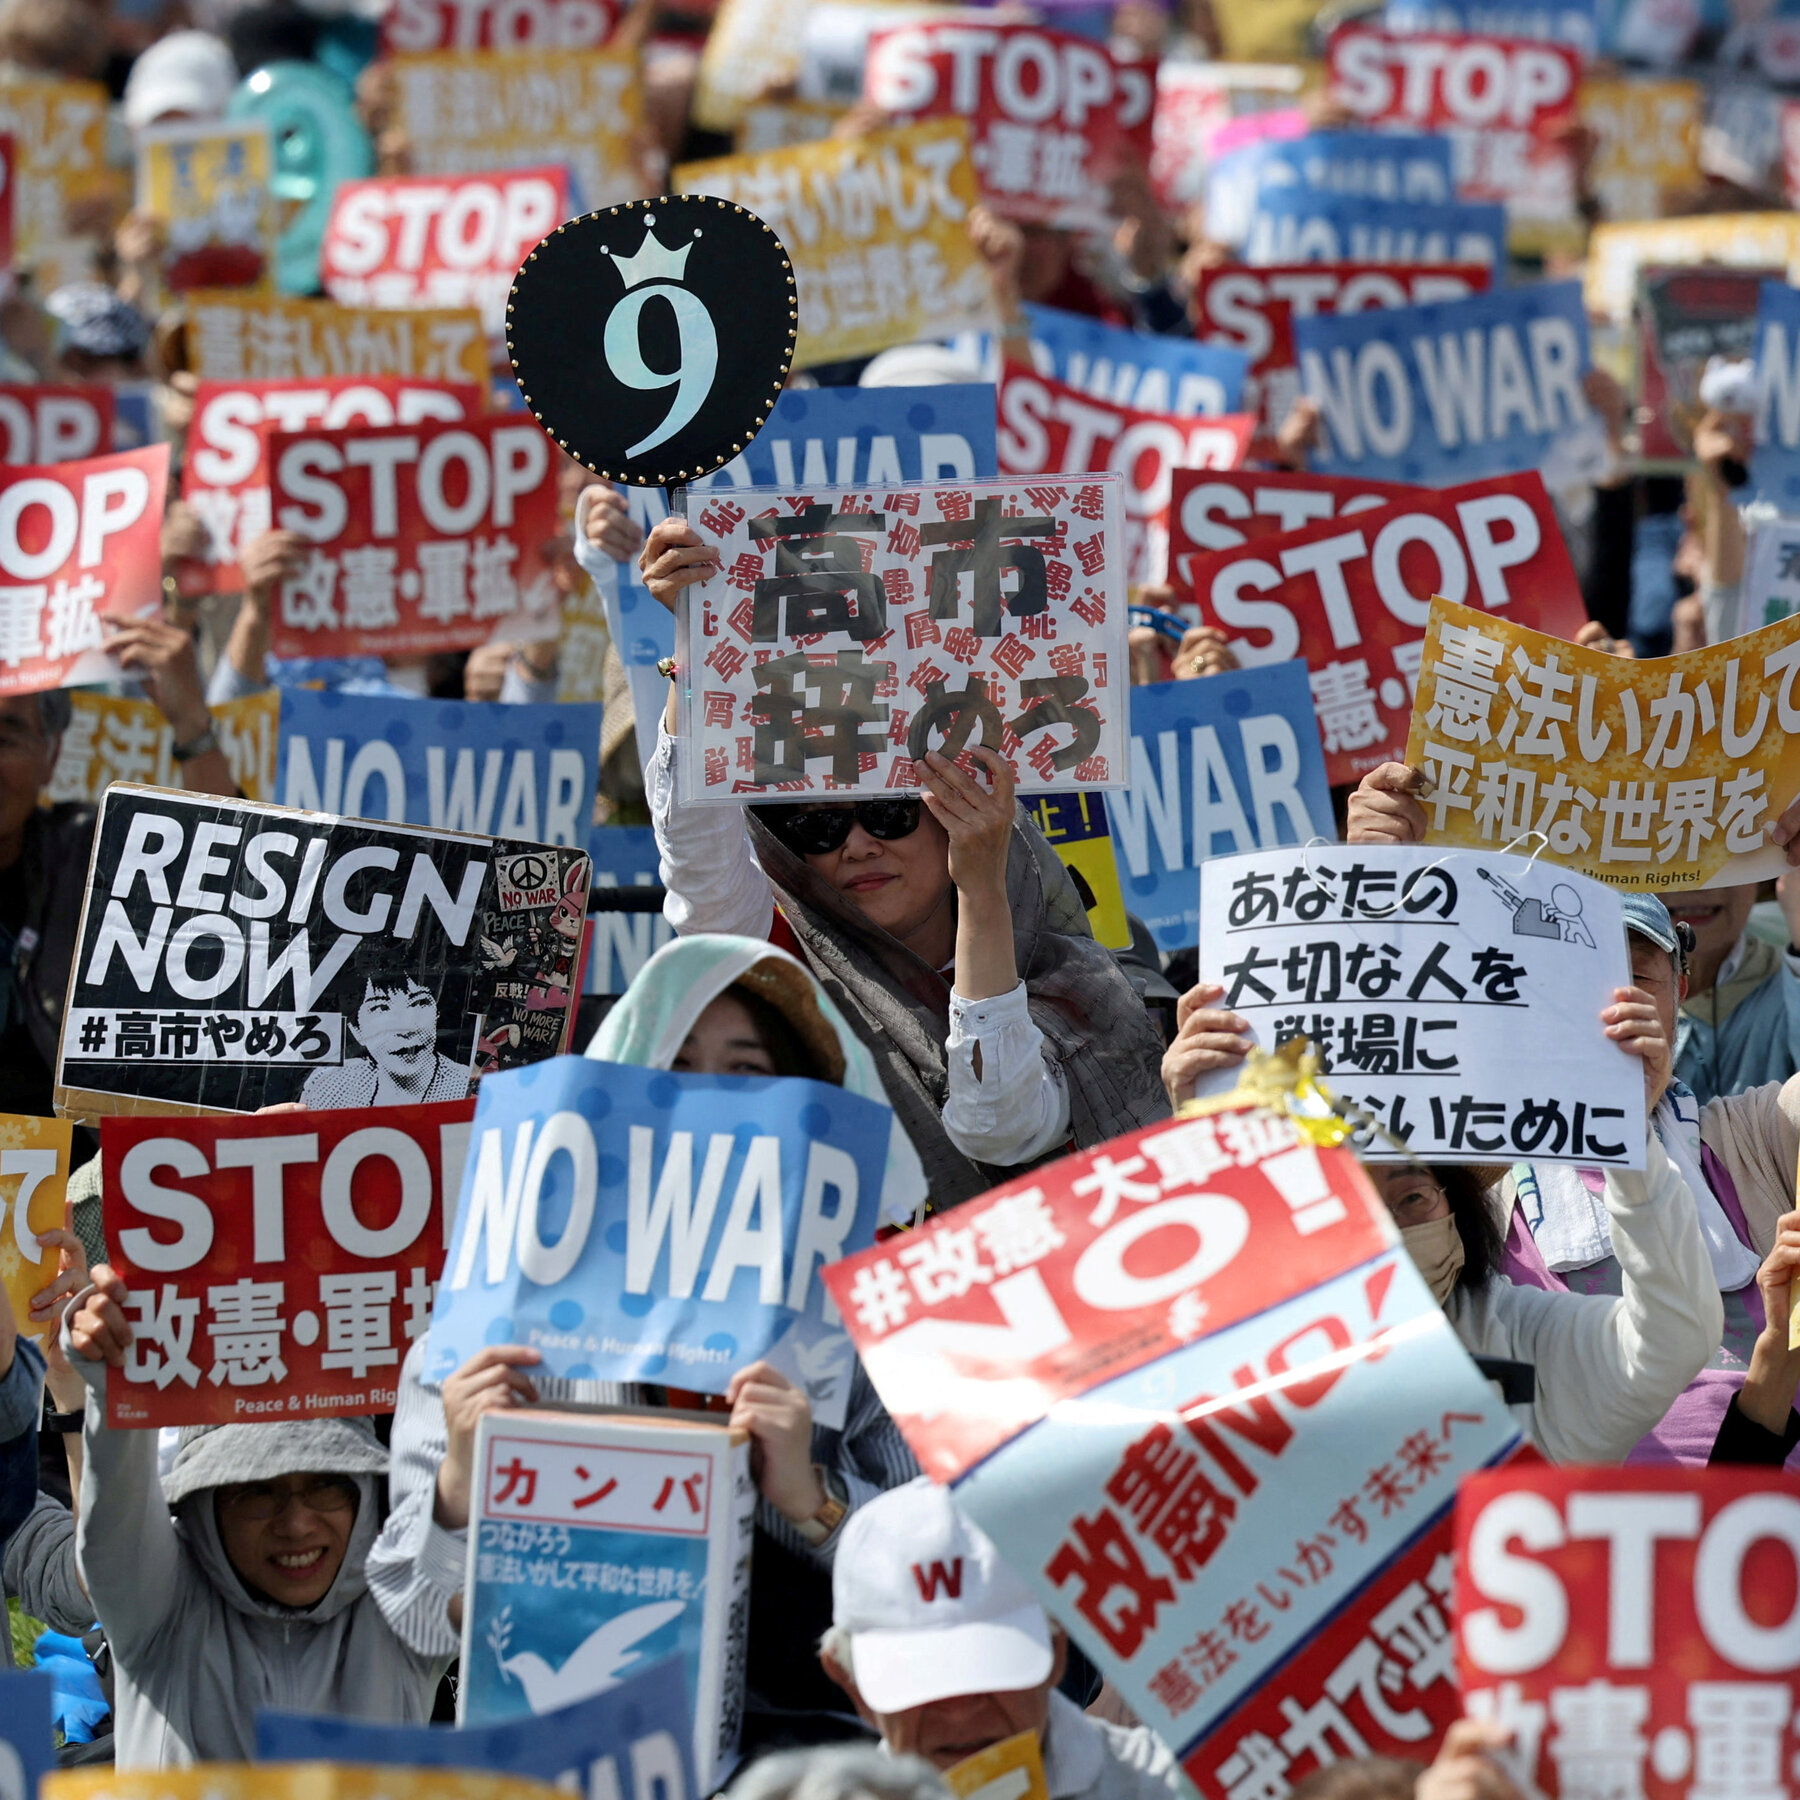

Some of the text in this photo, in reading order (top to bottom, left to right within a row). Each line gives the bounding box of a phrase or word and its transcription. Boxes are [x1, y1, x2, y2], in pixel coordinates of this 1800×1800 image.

[387, 0, 610, 51] STOP
[873, 27, 1113, 127] STOP
[1333, 35, 1571, 128] STOP
[328, 177, 557, 276] STOP
[604, 284, 719, 460] 9
[1302, 341, 1413, 462] NO
[1413, 316, 1592, 447] WAR
[0, 466, 149, 580] OP
[279, 424, 549, 543] STOP
[282, 535, 519, 632] 改憲・軍拡
[748, 499, 1056, 643] 高市
[1211, 493, 1540, 669] STOP
[751, 649, 1101, 785] 辞めろ
[286, 736, 586, 847] NO WAR
[1105, 713, 1303, 877] WAR
[1422, 740, 1770, 864] 平和な世界を
[110, 812, 487, 946] RESIGN
[502, 887, 558, 908] NO WAR
[1228, 864, 1458, 927] あなたの
[1645, 869, 1701, 886] Rights!
[85, 899, 363, 1013] NOW
[1223, 941, 1528, 1007] 大切な人を
[79, 1011, 333, 1061] #高市やめろ
[512, 1006, 561, 1031] NO MORE
[522, 1023, 557, 1045] WAR!
[1273, 1013, 1459, 1074] 戦場に
[451, 1110, 860, 1328] NO WAR
[849, 1186, 1068, 1334] #改憲
[529, 1329, 582, 1351] Peace
[601, 1336, 664, 1357] Human
[667, 1343, 732, 1366] Rights!
[234, 1398, 284, 1414] Peace
[287, 1396, 301, 1410] &
[305, 1393, 366, 1409] Human
[494, 1457, 704, 1515] カンパ
[480, 1523, 572, 1555] つながろう
[910, 1556, 963, 1603] W
[1147, 1410, 1485, 1720] 憲法をいかす未来へ
